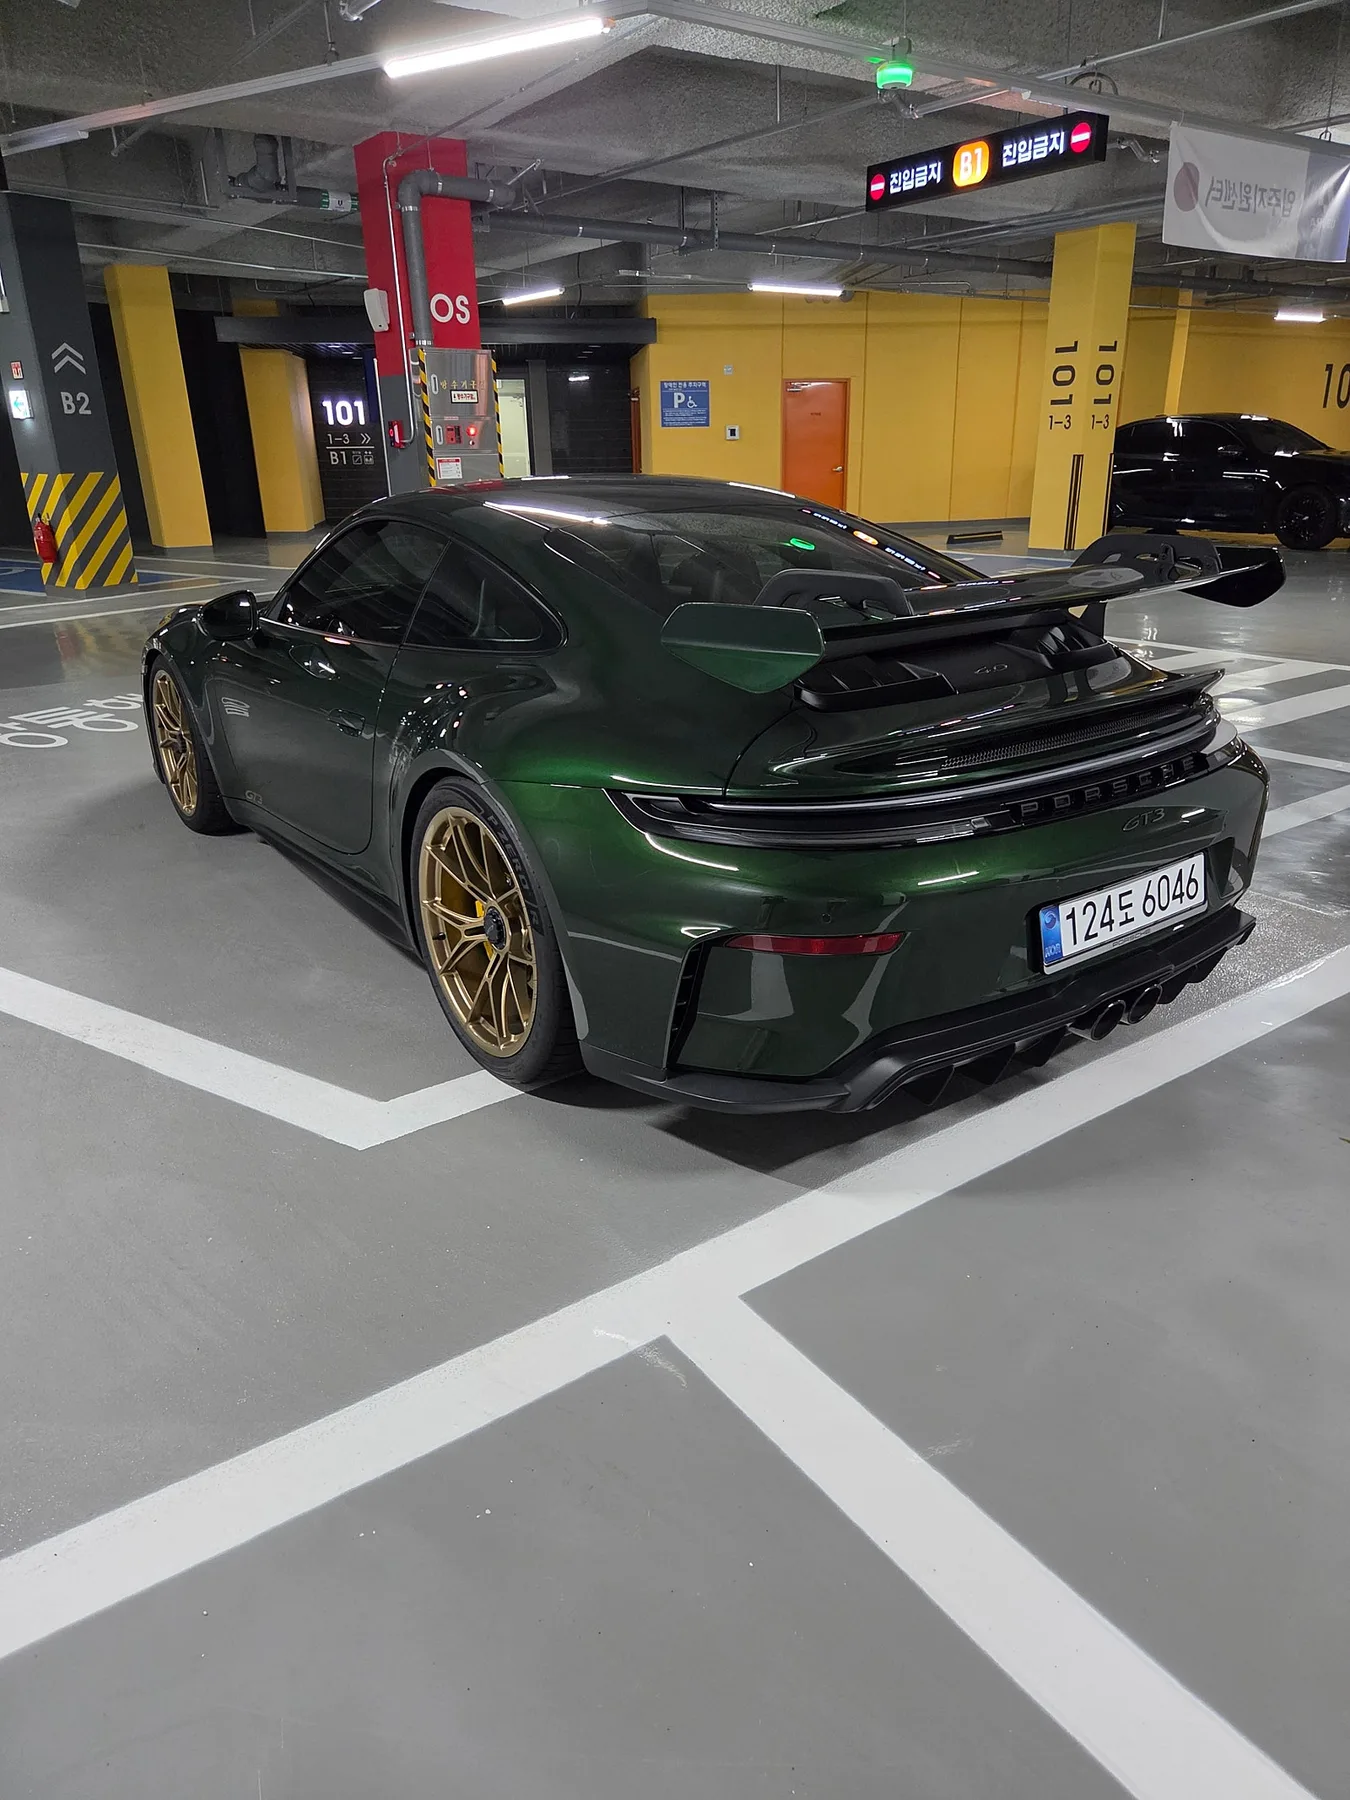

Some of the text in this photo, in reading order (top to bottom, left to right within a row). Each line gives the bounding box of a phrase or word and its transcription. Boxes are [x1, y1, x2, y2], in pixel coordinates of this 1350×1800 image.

[889, 130, 1065, 195] 진입금지 B1 진입금지
[429, 293, 471, 324] OS
[1050, 340, 1078, 405] 101
[1093, 340, 1118, 405] 101
[60, 391, 92, 415] B2
[673, 392, 686, 408] P
[321, 400, 366, 426] 101
[1048, 414, 1072, 430] 1-3
[1091, 414, 1110, 430] 1-3
[327, 433, 350, 444] 1-3
[329, 451, 347, 465] B1
[1020, 756, 1195, 817] PORSCHE
[1122, 808, 1166, 831] GT3
[1065, 863, 1199, 946] 124도 6046
